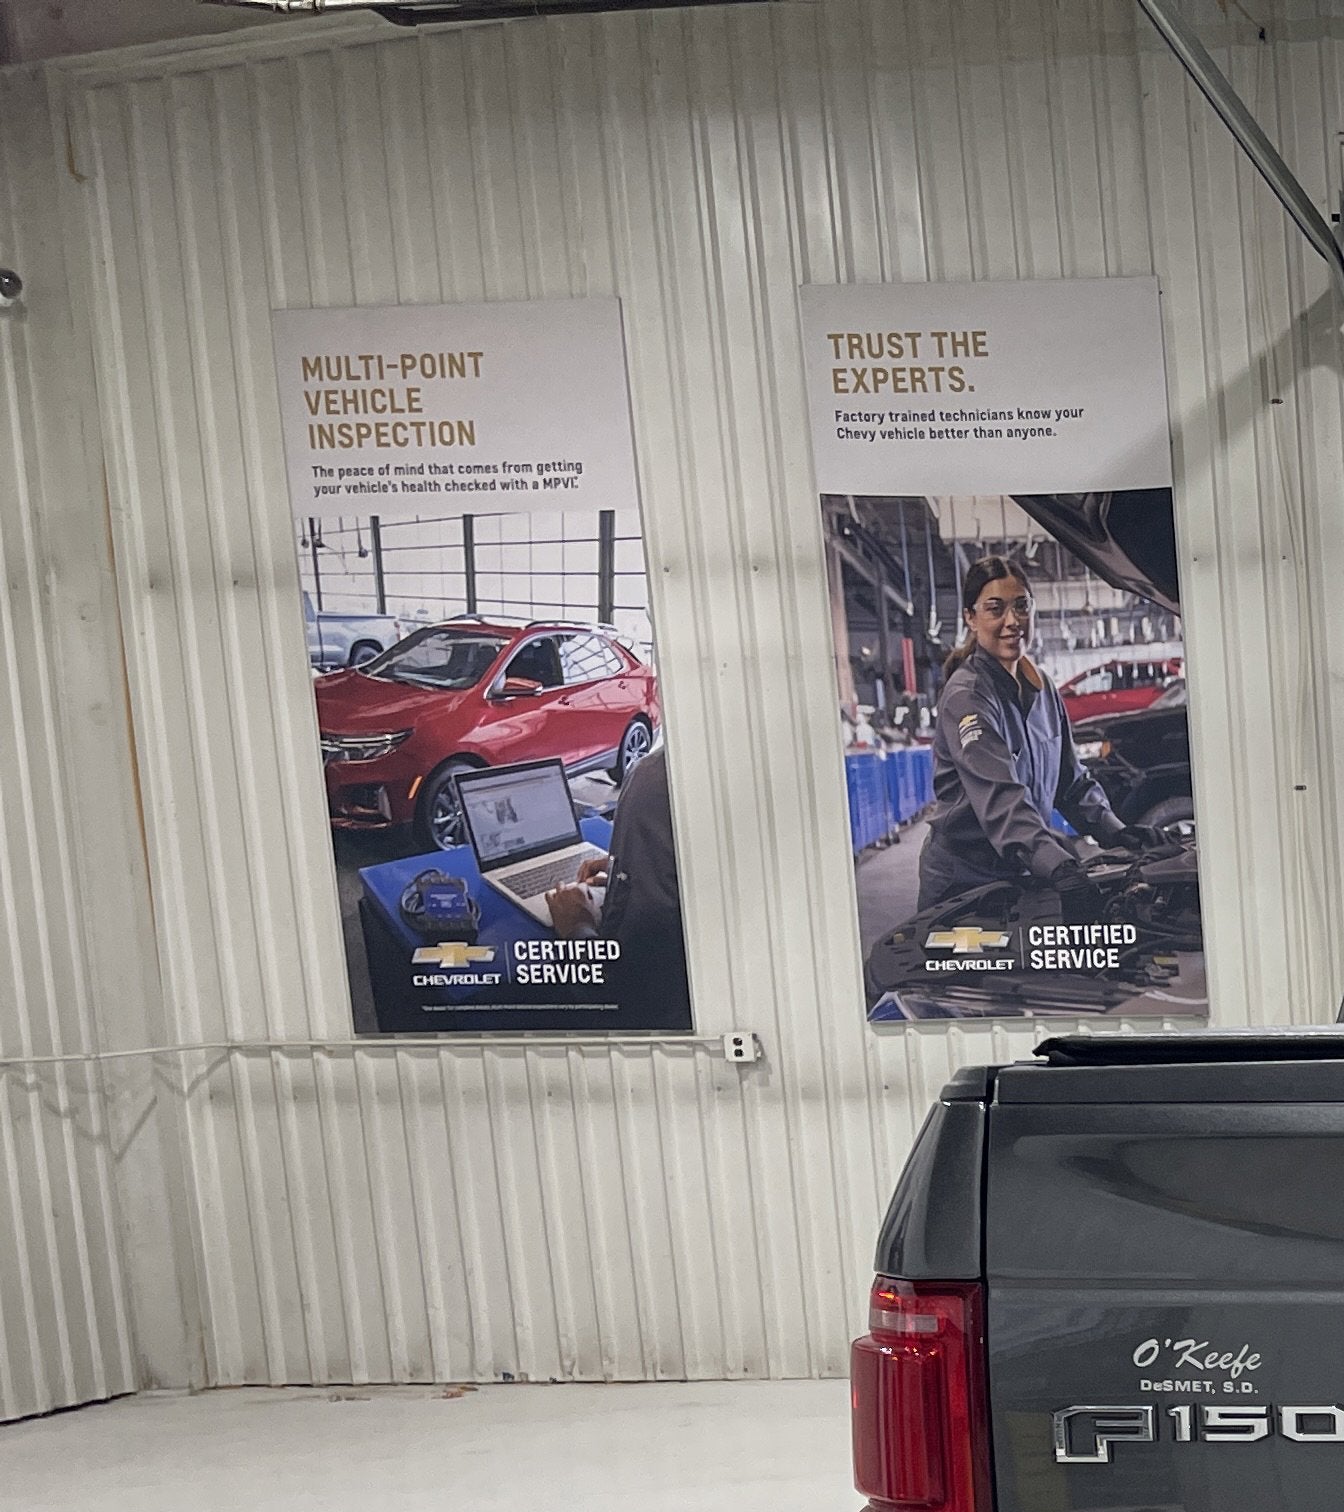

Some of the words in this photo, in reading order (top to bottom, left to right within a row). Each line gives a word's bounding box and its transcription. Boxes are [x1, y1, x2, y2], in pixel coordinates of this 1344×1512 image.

[827, 331, 923, 360] TRUST
[930, 330, 990, 358] THE
[301, 352, 484, 382] MULTI-POINT
[831, 366, 976, 394] EXPERTS.
[303, 387, 423, 416] VEHICLE
[835, 409, 885, 425] Factory
[888, 410, 936, 422] trained
[939, 408, 1014, 422] technicians
[1016, 407, 1051, 420] know
[1054, 408, 1084, 422] your
[308, 420, 476, 450] INSPECTION
[836, 427, 877, 442] Chevy
[879, 426, 925, 440] vehicle
[929, 427, 970, 439] better
[973, 426, 1003, 438] than
[1006, 426, 1057, 440] anyone.
[312, 465, 334, 478] The
[338, 466, 374, 480] peace
[378, 464, 390, 476] of
[394, 463, 425, 476] mind
[428, 463, 455, 475] that
[457, 464, 499, 475] comes
[502, 461, 533, 473] from
[536, 460, 583, 475] getting
[313, 483, 342, 497] your
[344, 480, 399, 494] vehicle's
[401, 480, 441, 492] health
[444, 478, 497, 491] checked
[499, 477, 528, 491] with
[532, 480, 539, 490] a
[1028, 924, 1137, 947] CERTIFIED
[513, 939, 621, 962] CERTIFIED
[1030, 948, 1120, 970] SERVICE
[516, 964, 605, 985] SERVICE
[925, 959, 1015, 971] CHEVROLET
[412, 972, 502, 986] CHEVROLET
[1132, 1338, 1263, 1379] O'Keefe
[1140, 1379, 1217, 1395] DeSMET,
[1223, 1380, 1259, 1394] S.D.
